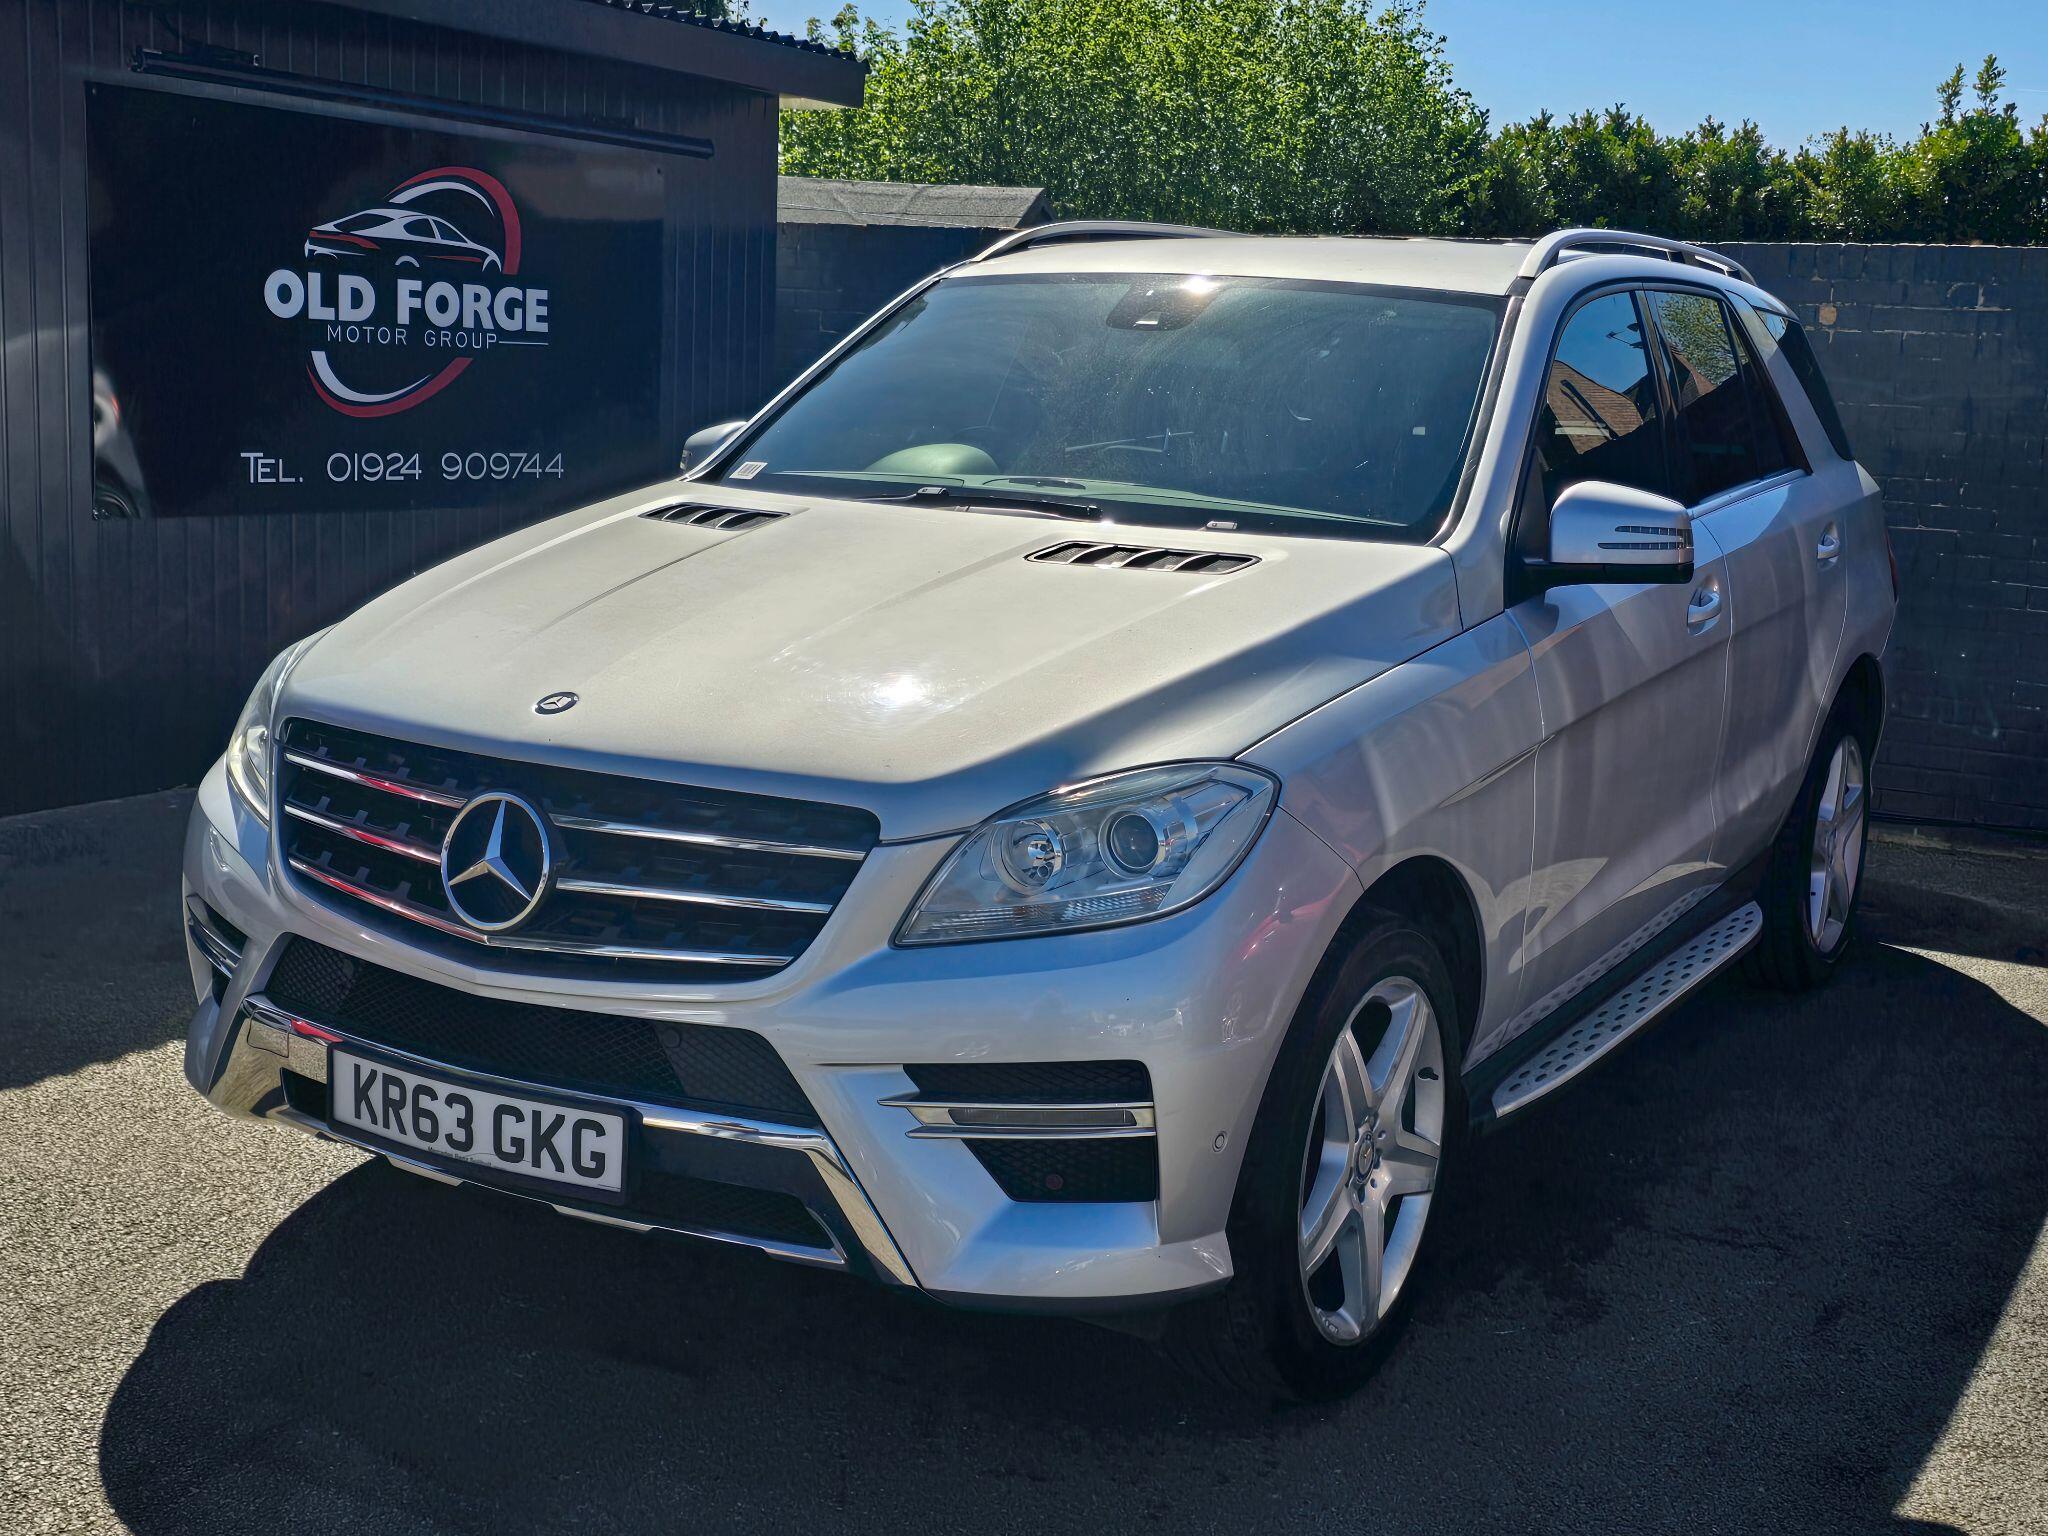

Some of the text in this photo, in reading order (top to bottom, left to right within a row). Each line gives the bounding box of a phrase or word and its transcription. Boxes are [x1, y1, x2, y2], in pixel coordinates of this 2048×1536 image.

[264, 269, 549, 333] OLD FORGE
[327, 324, 497, 349] MOTOR GROUP
[327, 452, 422, 482] 01924
[441, 452, 564, 480] 909744
[353, 1063, 606, 1179] KR63 GKG
